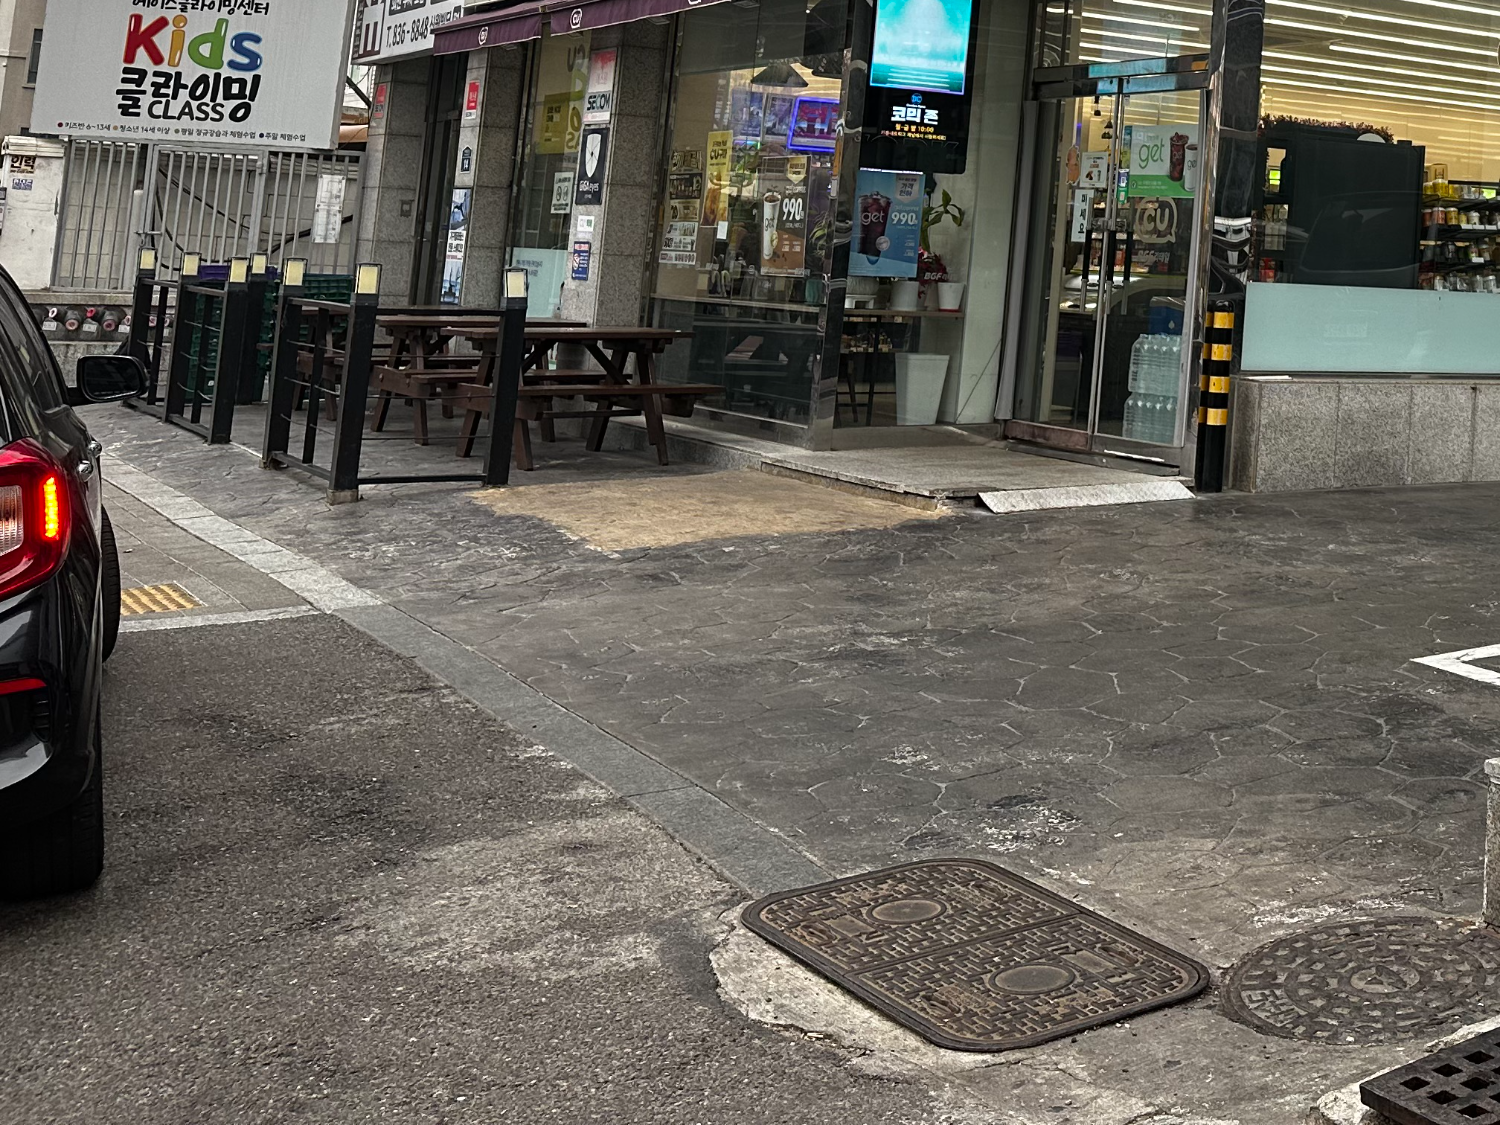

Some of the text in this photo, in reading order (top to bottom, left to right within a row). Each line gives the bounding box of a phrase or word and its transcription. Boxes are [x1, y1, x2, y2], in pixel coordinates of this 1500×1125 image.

[122, 13, 263, 72] Kids
[116, 66, 261, 123] 클라이밍
[147, 100, 225, 122] CLASS
[891, 106, 938, 125] 코믹 존
[1138, 138, 1165, 170] get
[861, 210, 885, 225] get
[1144, 207, 1170, 231] CU
